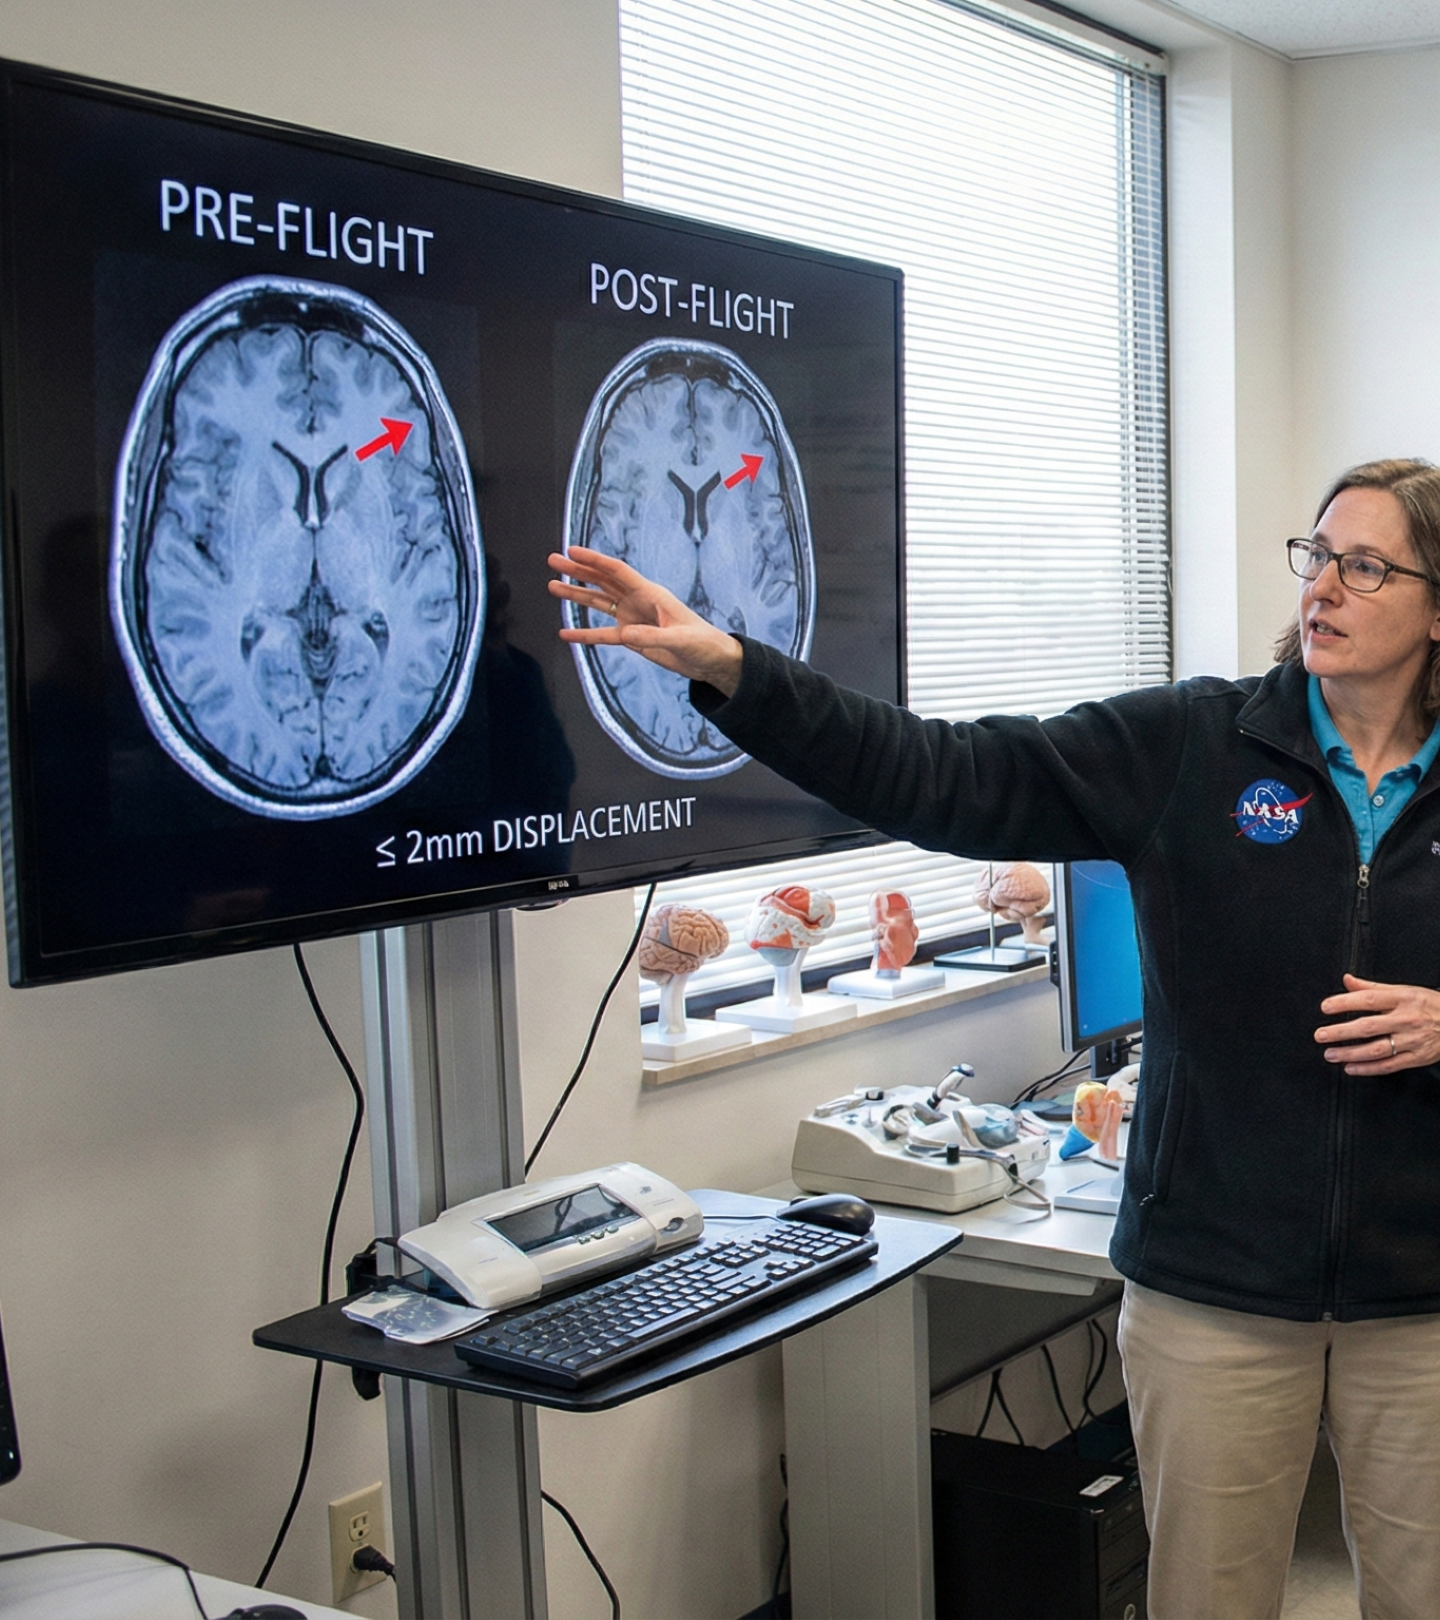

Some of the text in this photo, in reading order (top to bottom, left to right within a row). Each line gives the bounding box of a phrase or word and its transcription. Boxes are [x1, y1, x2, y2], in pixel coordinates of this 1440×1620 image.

[160, 179, 434, 275] PRE-FLIGHT
[590, 262, 795, 339] POST-FLIGHT
[406, 830, 484, 864] 2mm
[492, 797, 697, 852] DISPLACEMENT
[1242, 800, 1300, 825] NASA
